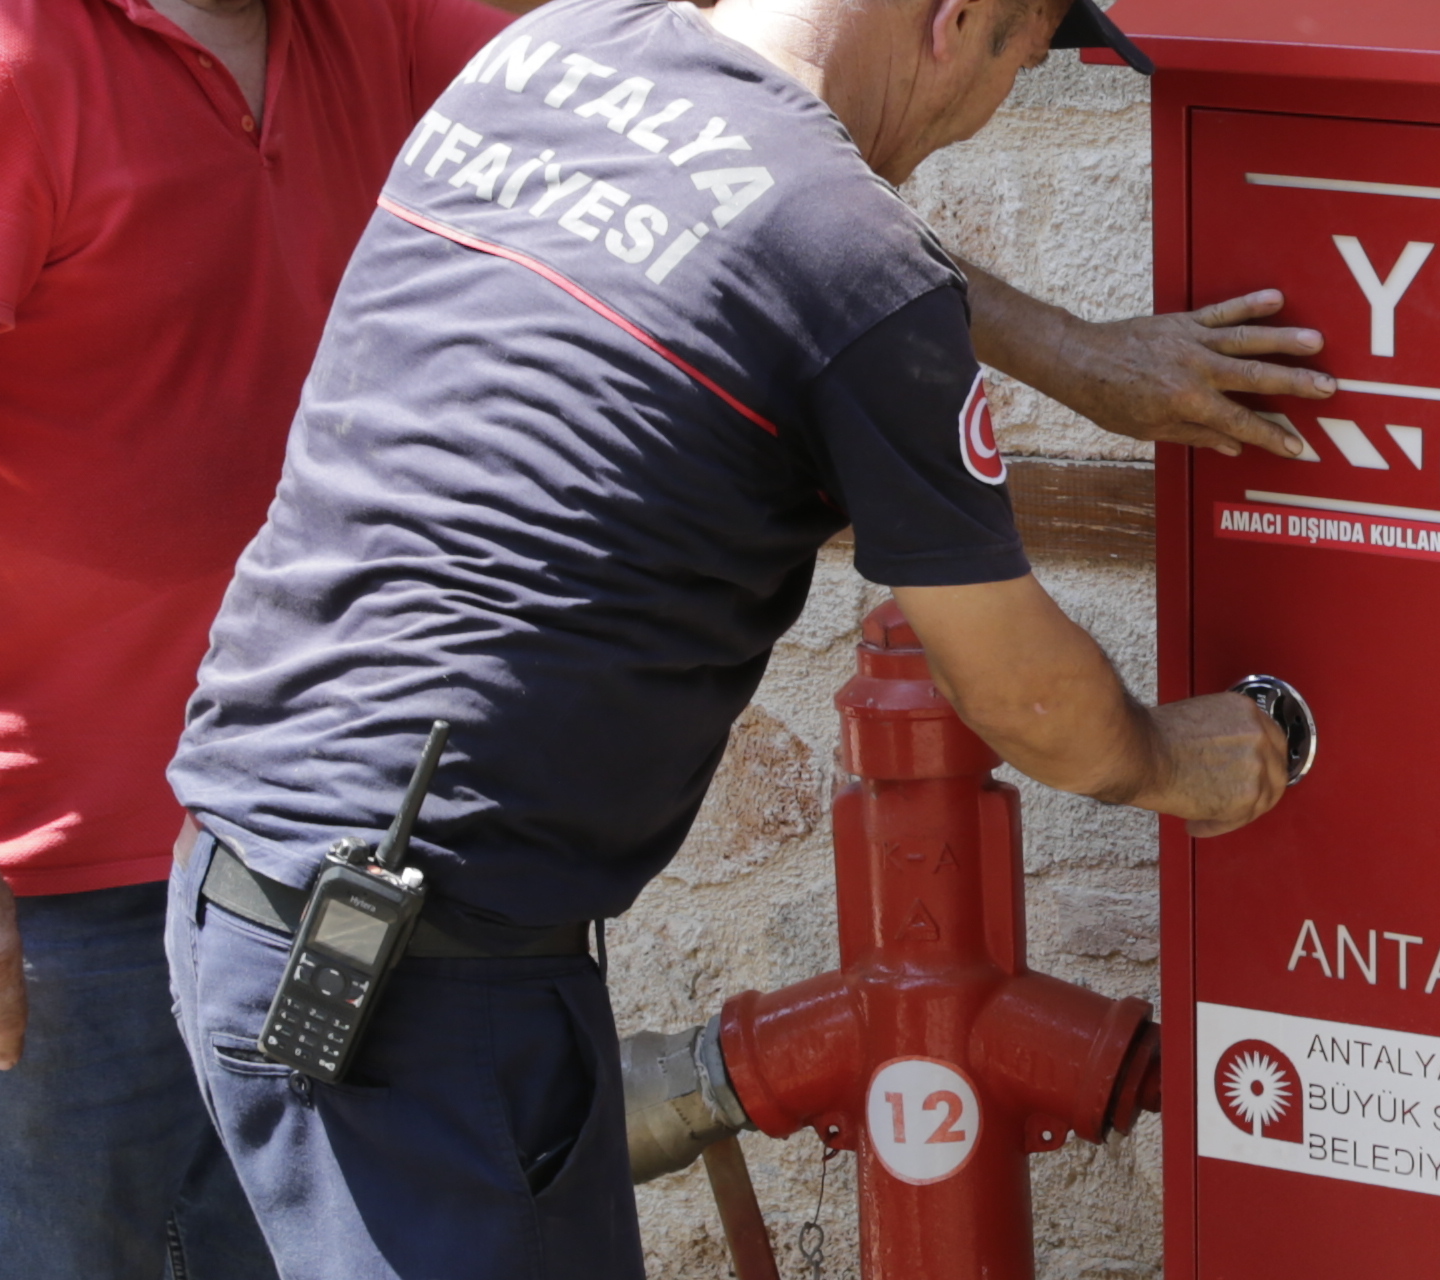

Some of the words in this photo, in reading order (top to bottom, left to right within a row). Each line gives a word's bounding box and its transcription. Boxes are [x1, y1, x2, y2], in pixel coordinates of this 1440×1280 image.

[403, 109, 710, 285] TFAİYESİ
[1220, 509, 1282, 535] AMACI
[1287, 515, 1365, 544] DIŞINDA
[883, 1089, 967, 1145] 12
[1308, 1081, 1421, 1129] BÜYÜK
